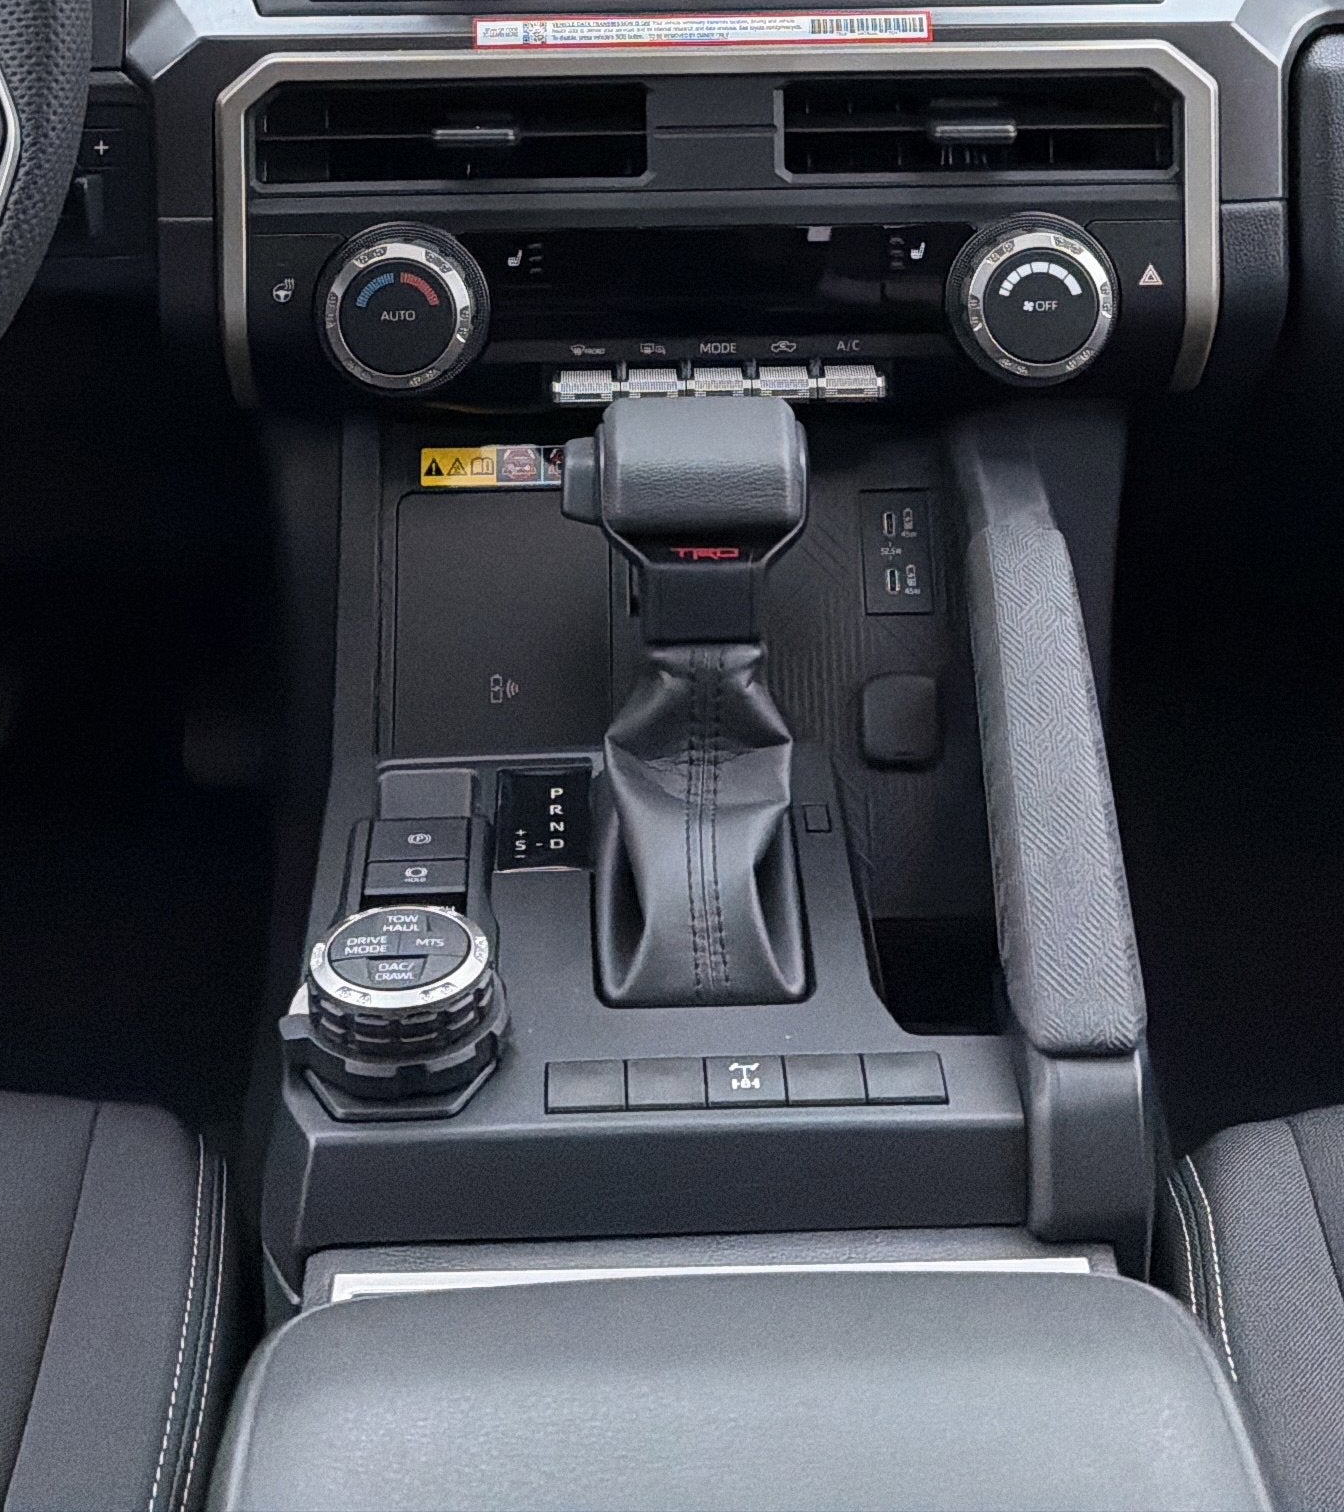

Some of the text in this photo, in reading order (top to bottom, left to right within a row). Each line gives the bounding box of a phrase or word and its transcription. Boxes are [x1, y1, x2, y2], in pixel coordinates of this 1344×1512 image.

[1035, 299, 1059, 312] OFF
[380, 309, 416, 322] AUTO
[699, 342, 738, 354] MODE
[836, 340, 861, 352] A/C
[669, 547, 739, 560] TRD
[550, 787, 564, 799] P
[549, 804, 564, 816] R
[549, 821, 565, 832] N
[514, 838, 565, 851] S D
[387, 914, 419, 923] TOW
[382, 923, 420, 932] HAUL
[346, 935, 388, 947] DRIVE
[415, 937, 445, 947] MTS
[344, 944, 388, 956] MODE
[378, 961, 414, 972] DAC/
[374, 971, 415, 982] CRAWL
